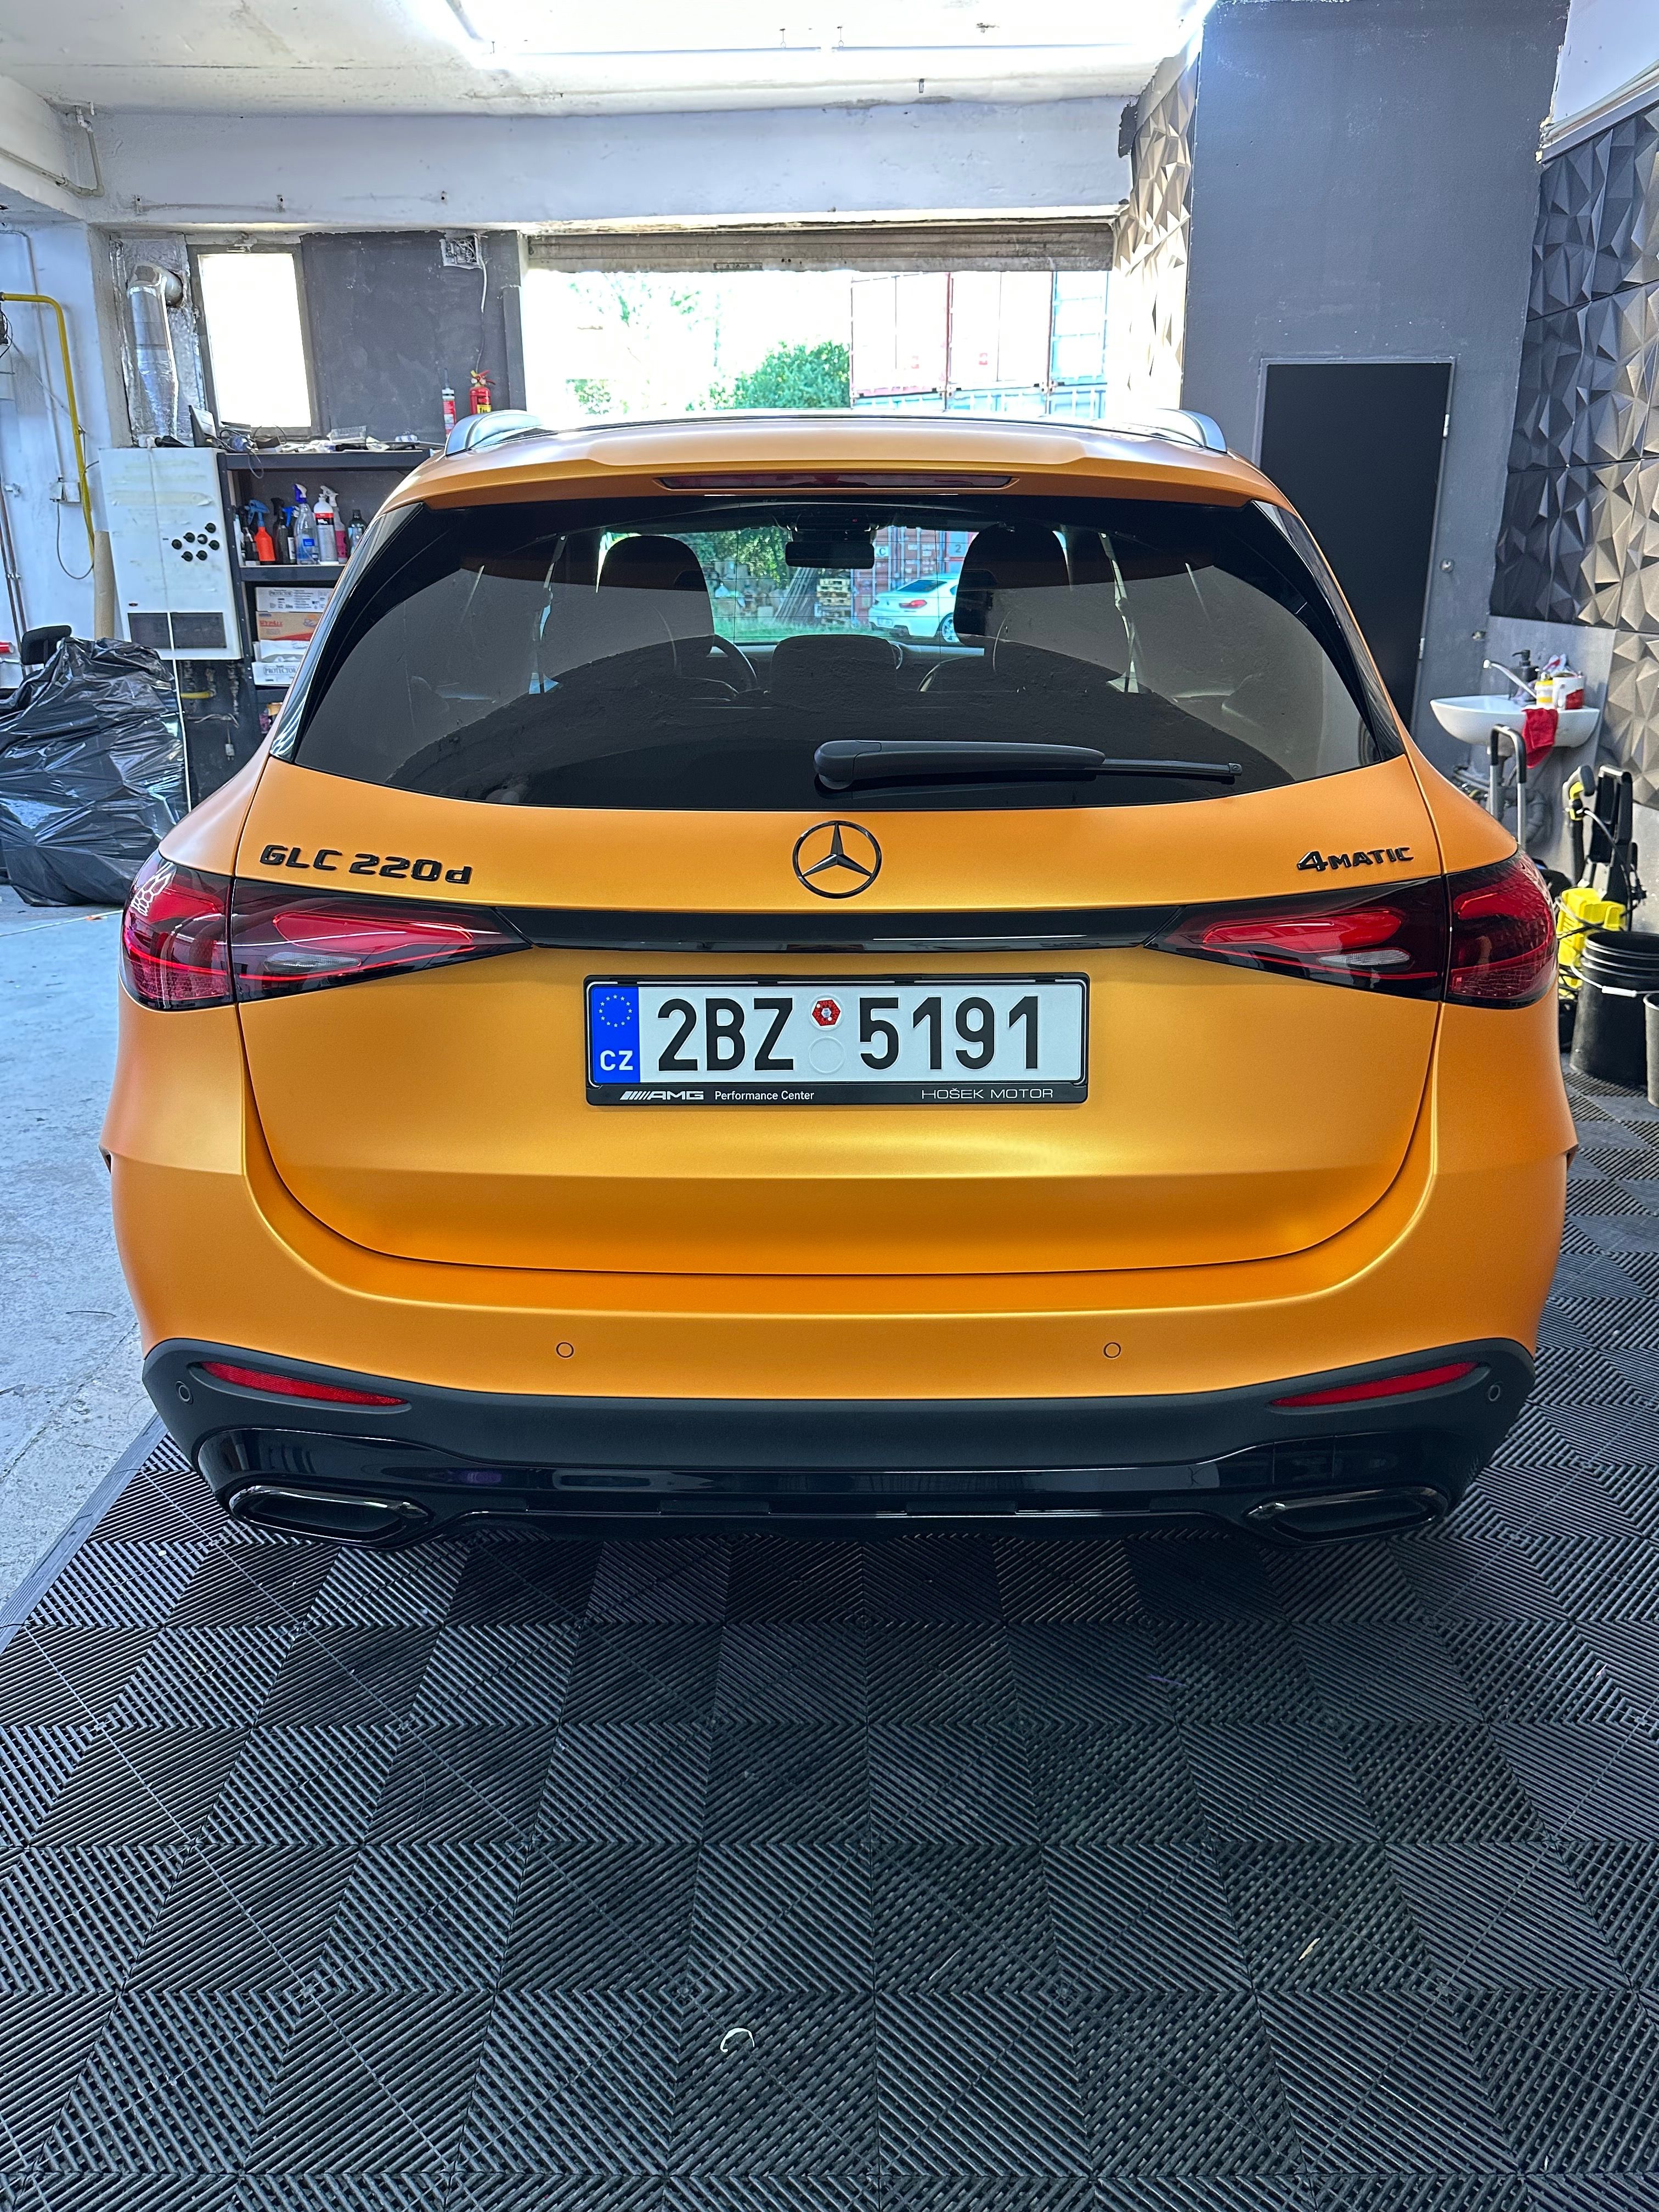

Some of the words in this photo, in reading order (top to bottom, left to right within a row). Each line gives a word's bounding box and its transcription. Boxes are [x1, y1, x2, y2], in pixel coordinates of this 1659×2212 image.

[955, 544, 962, 553] 2
[259, 844, 343, 871] GLC
[1296, 847, 1415, 872] 4MATIC
[657, 997, 794, 1071] 2BZ
[859, 996, 1039, 1070] 5191
[600, 1050, 633, 1071] CZ
[650, 1091, 704, 1100] AMG
[715, 1091, 778, 1100] Performance
[781, 1090, 815, 1100] Center
[922, 1087, 984, 1099] HOŠEK
[990, 1088, 1053, 1099] MOTOR
